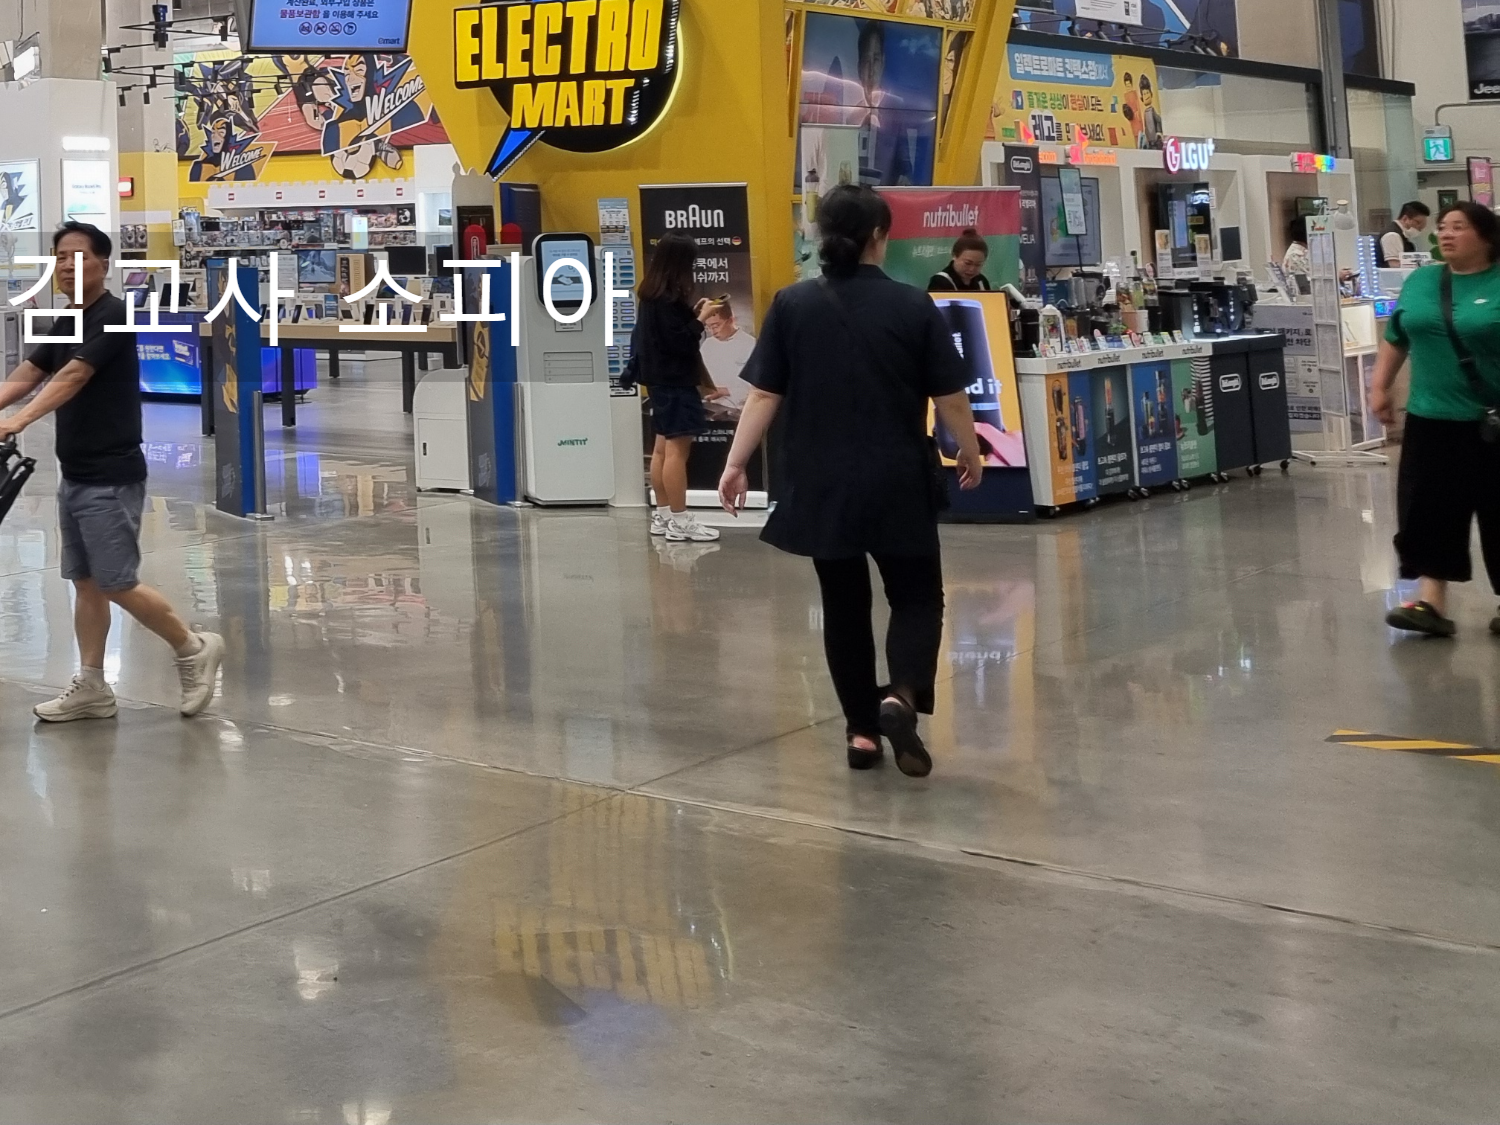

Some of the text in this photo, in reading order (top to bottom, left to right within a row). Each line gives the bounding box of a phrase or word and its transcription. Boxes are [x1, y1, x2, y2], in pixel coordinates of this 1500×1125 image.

[365, 75, 424, 125] WELCOME
[510, 78, 635, 130] MART
[220, 147, 263, 171] WELCOME
[665, 204, 724, 229] BRAUN
[923, 203, 979, 227] nutribullet
[717, 237, 731, 246] 선택
